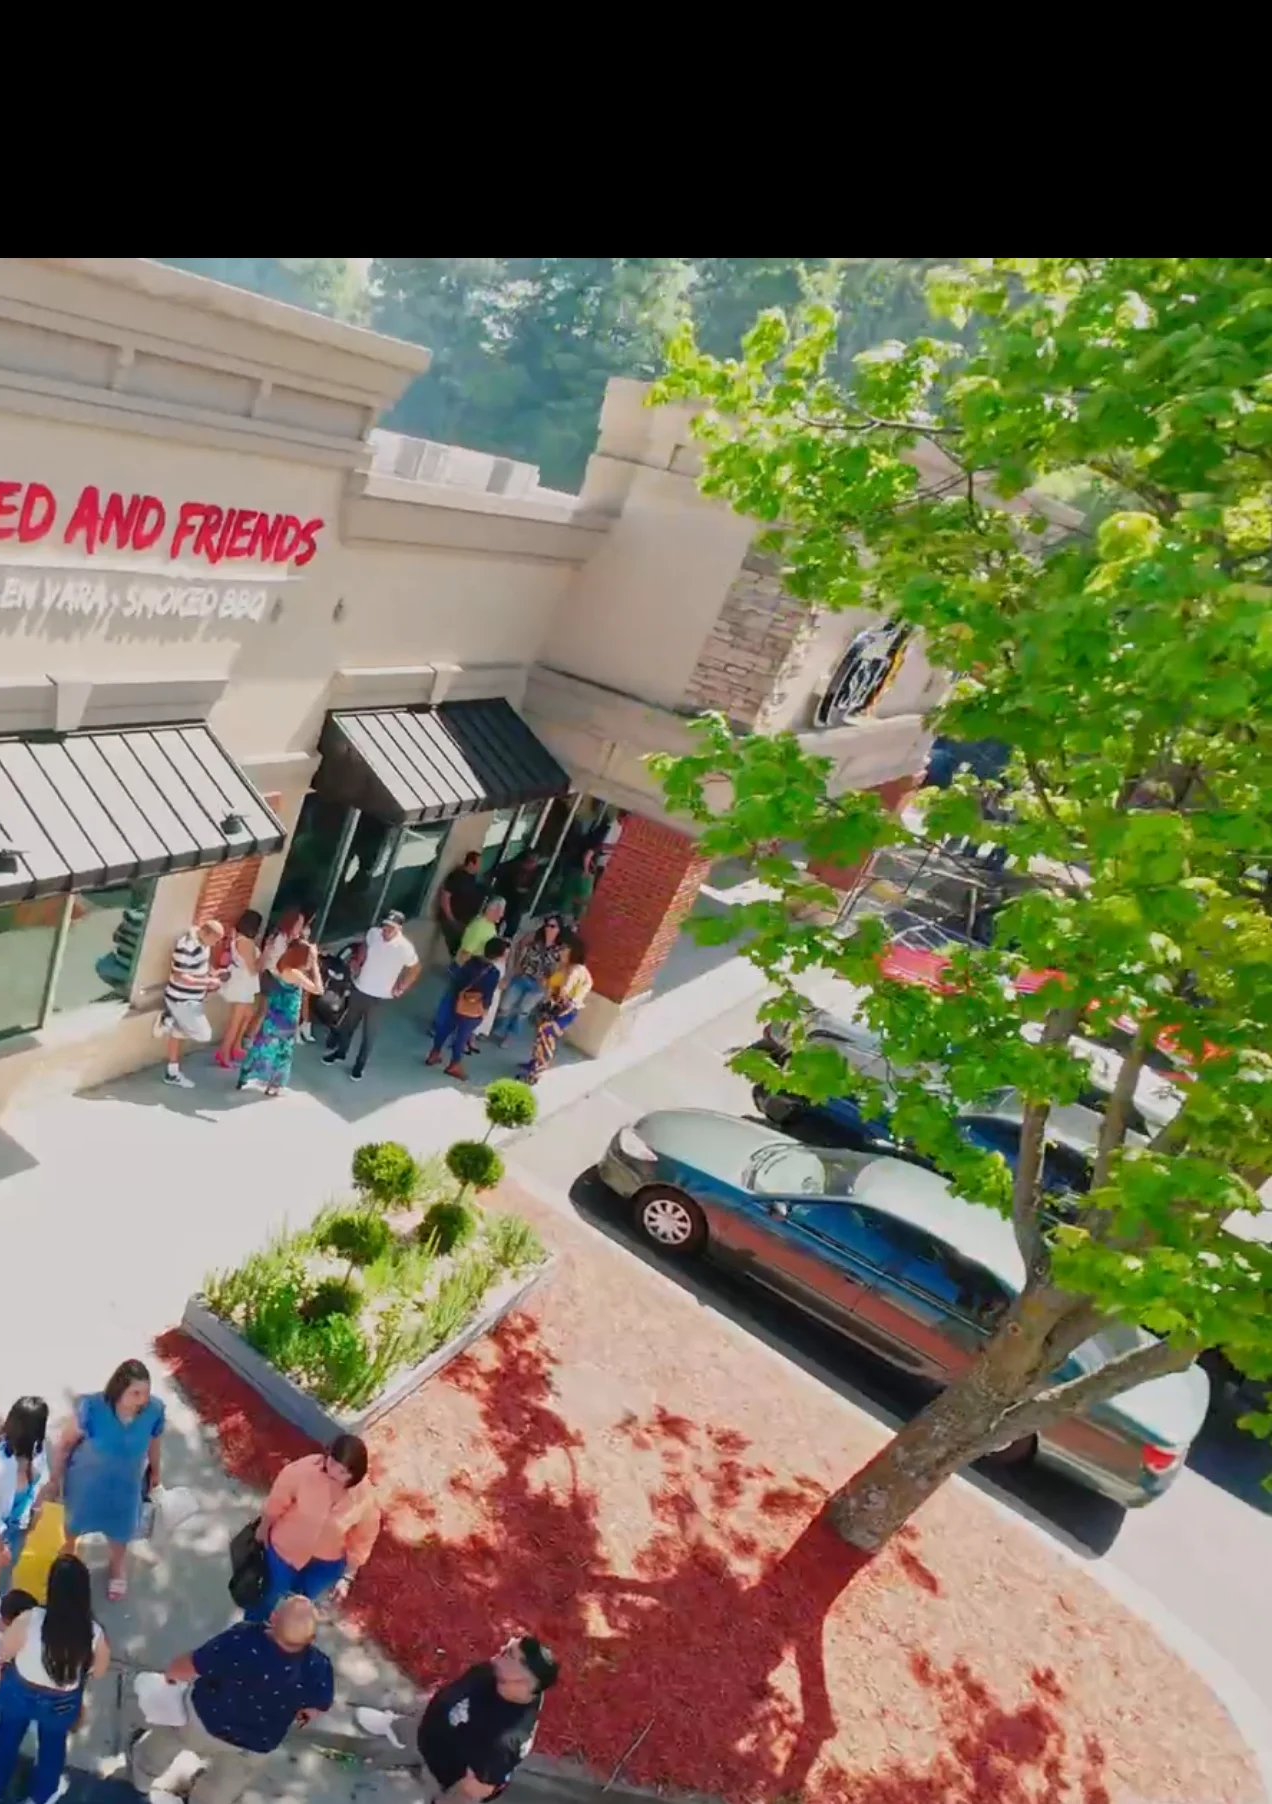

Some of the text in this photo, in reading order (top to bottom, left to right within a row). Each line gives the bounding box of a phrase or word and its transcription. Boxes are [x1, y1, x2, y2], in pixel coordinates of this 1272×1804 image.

[64, 485, 166, 554] AND
[169, 502, 324, 566] FRIENDS
[0, 577, 41, 610] EN
[122, 584, 218, 619] SMOKED
[219, 588, 268, 622] BBQ
